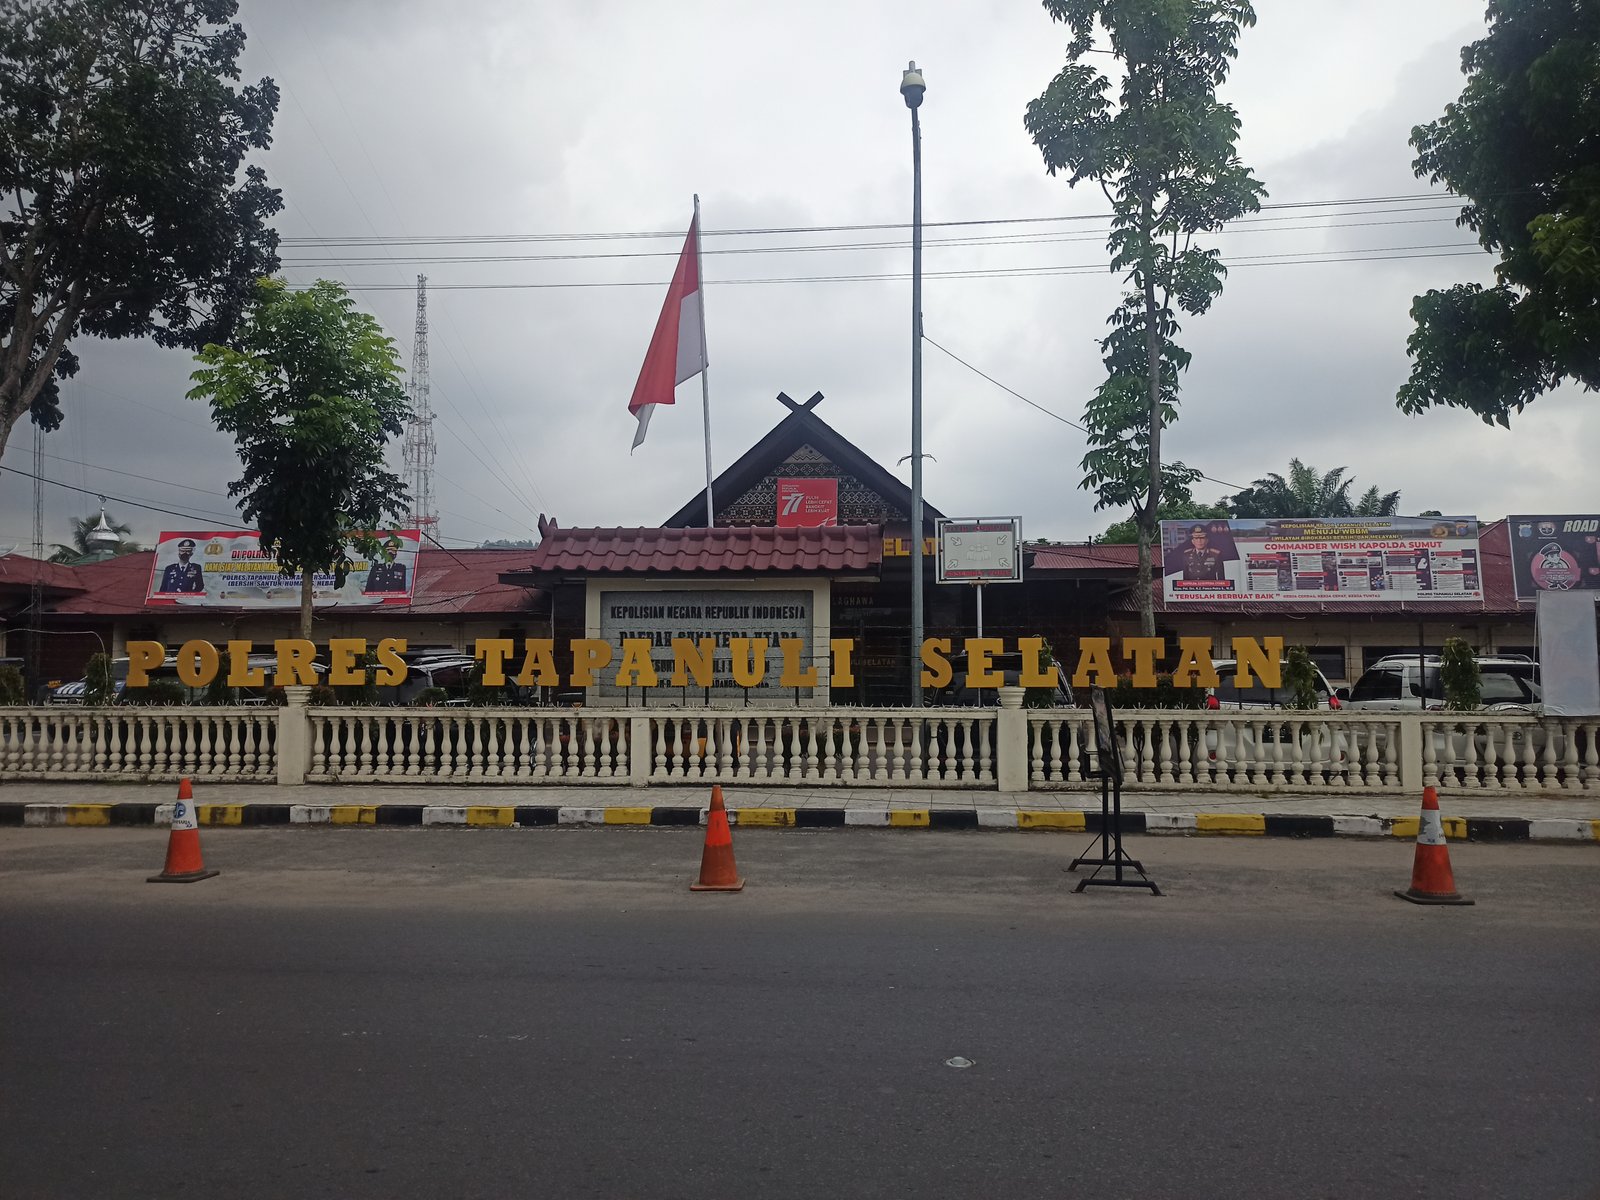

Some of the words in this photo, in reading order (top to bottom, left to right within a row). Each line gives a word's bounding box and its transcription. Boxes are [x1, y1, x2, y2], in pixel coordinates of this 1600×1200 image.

[1563, 519, 1599, 532] ROAD
[1408, 541, 1443, 549] SUMUT
[611, 606, 664, 619] KEPOLISIAN
[667, 606, 702, 619] NEGARA
[705, 606, 750, 619] REPUBLIK
[752, 606, 805, 619] INDONESIA
[125, 638, 408, 687] POLRES
[475, 638, 854, 688] TAPANULI
[920, 636, 1284, 688] SELATAN
